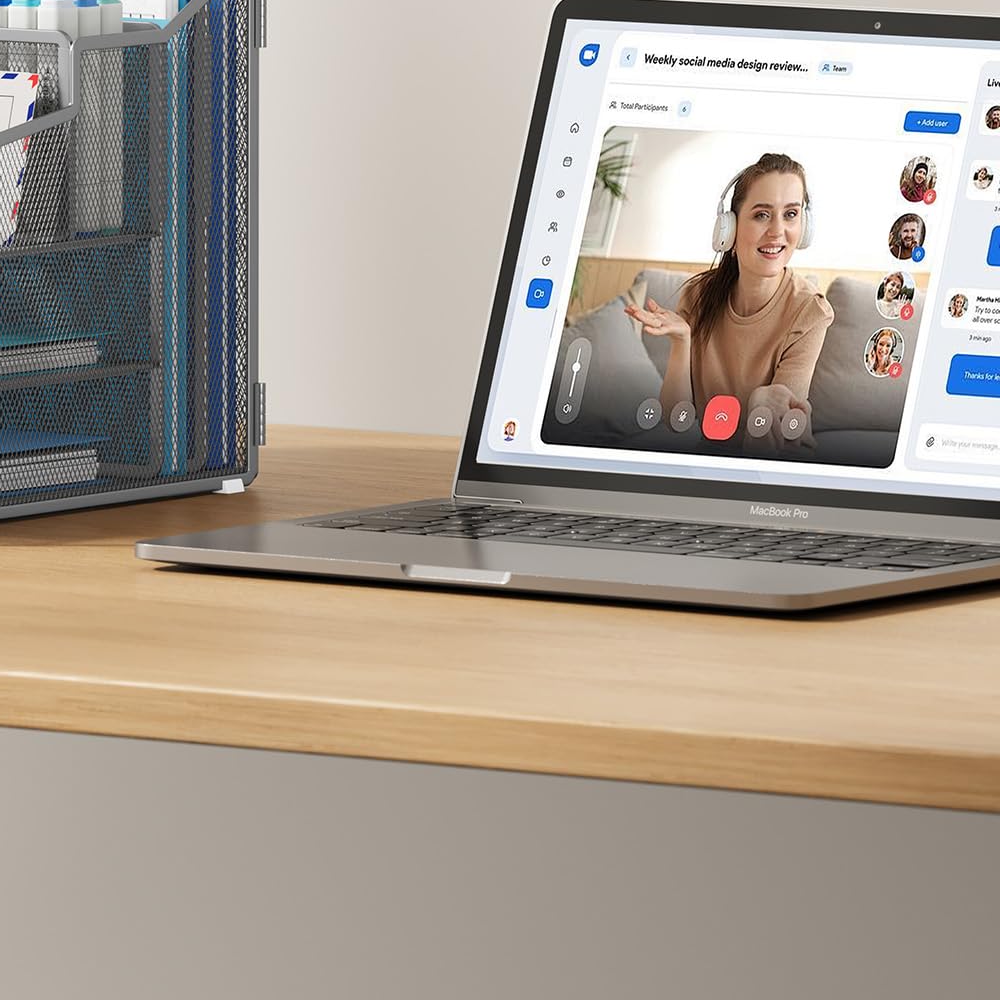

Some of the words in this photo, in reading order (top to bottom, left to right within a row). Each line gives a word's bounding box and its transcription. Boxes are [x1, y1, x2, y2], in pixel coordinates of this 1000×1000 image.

[644, 53, 677, 68] Weekly
[679, 56, 706, 67] social
[707, 58, 735, 68] media
[737, 58, 768, 72] design
[769, 60, 808, 72] review...
[833, 64, 847, 73] Team
[621, 102, 634, 110] Total
[634, 102, 668, 112] Participants
[921, 119, 935, 127] Add
[975, 306, 985, 315] Try
[965, 371, 985, 380] Thanks
[750, 505, 792, 518] MacBook
[793, 508, 809, 519] Pro
